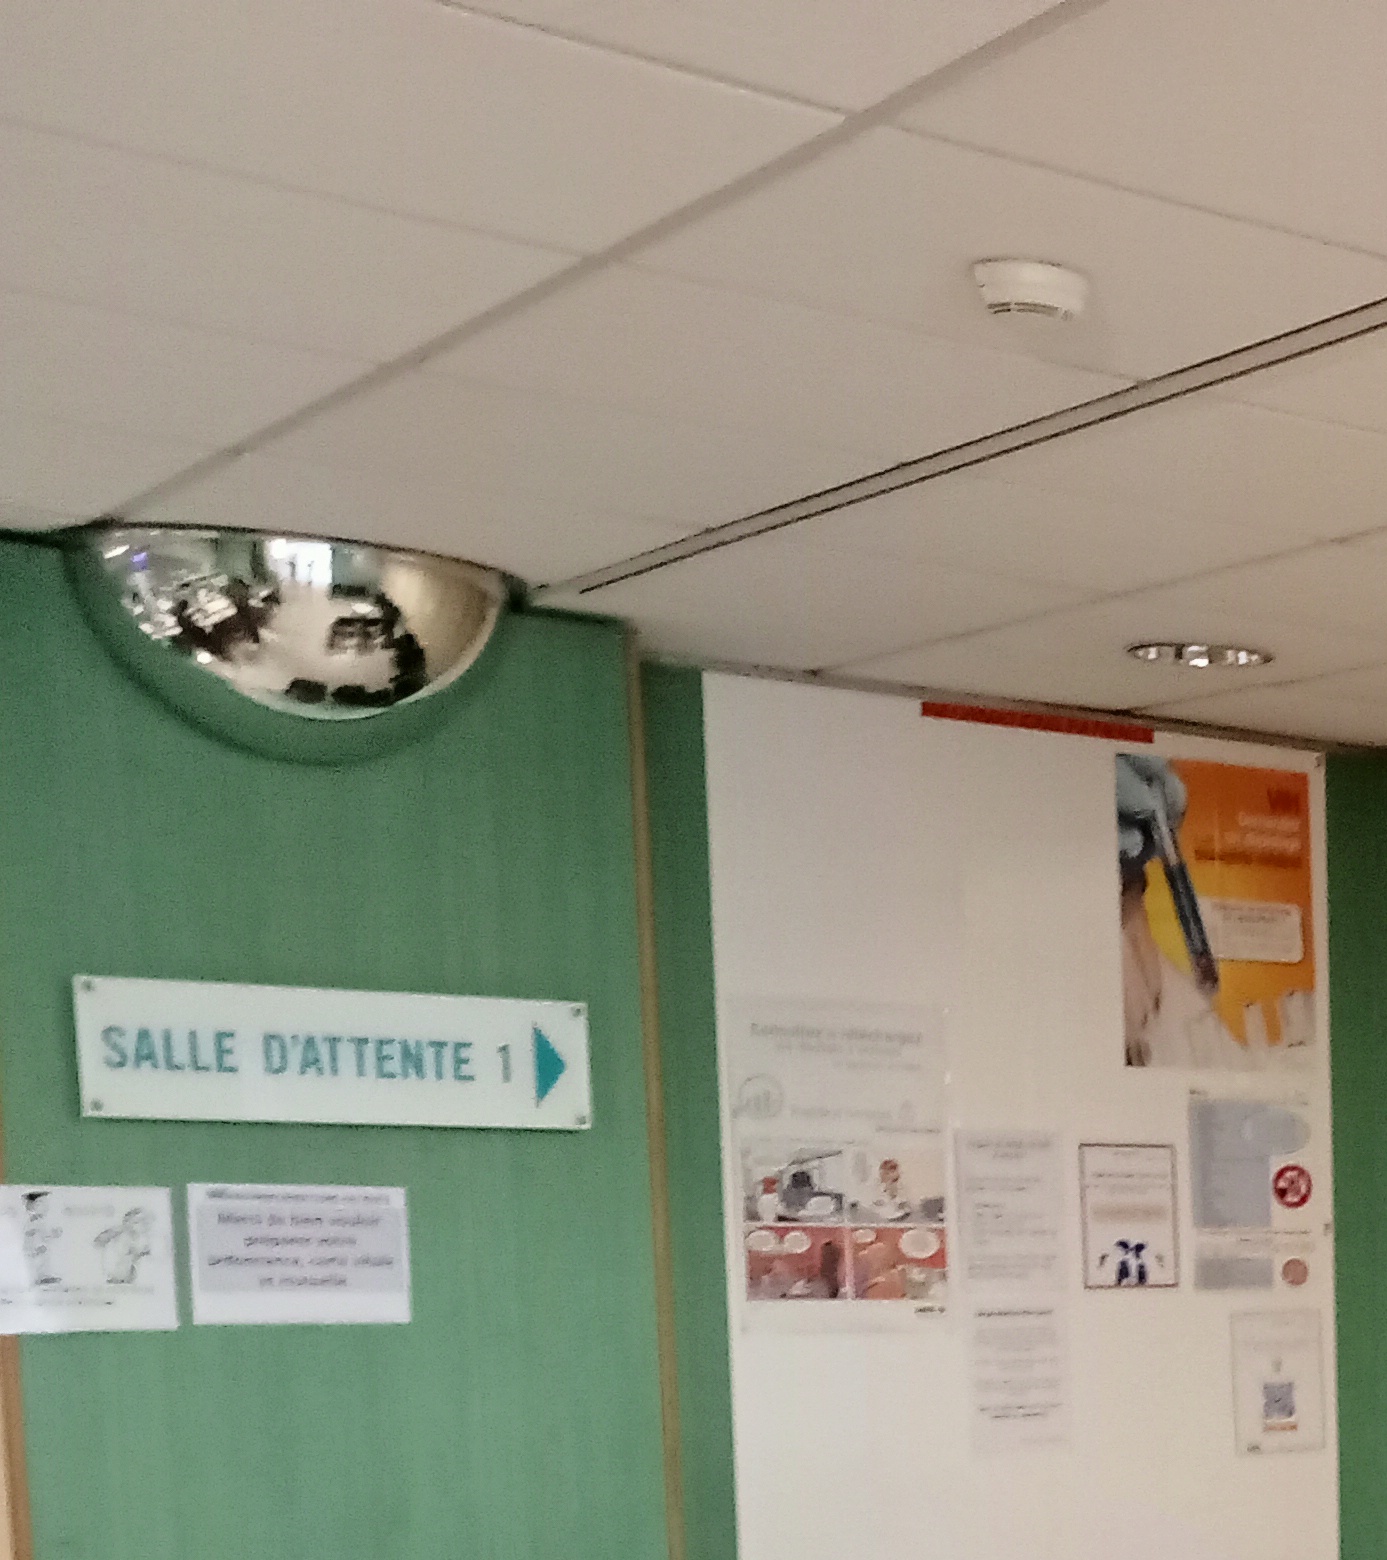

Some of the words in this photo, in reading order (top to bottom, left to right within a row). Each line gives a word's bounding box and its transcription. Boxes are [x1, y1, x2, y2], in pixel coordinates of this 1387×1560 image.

[101, 1024, 239, 1074] SALLE
[262, 1031, 476, 1082] D'ATTENTE
[497, 1044, 513, 1083] 1
